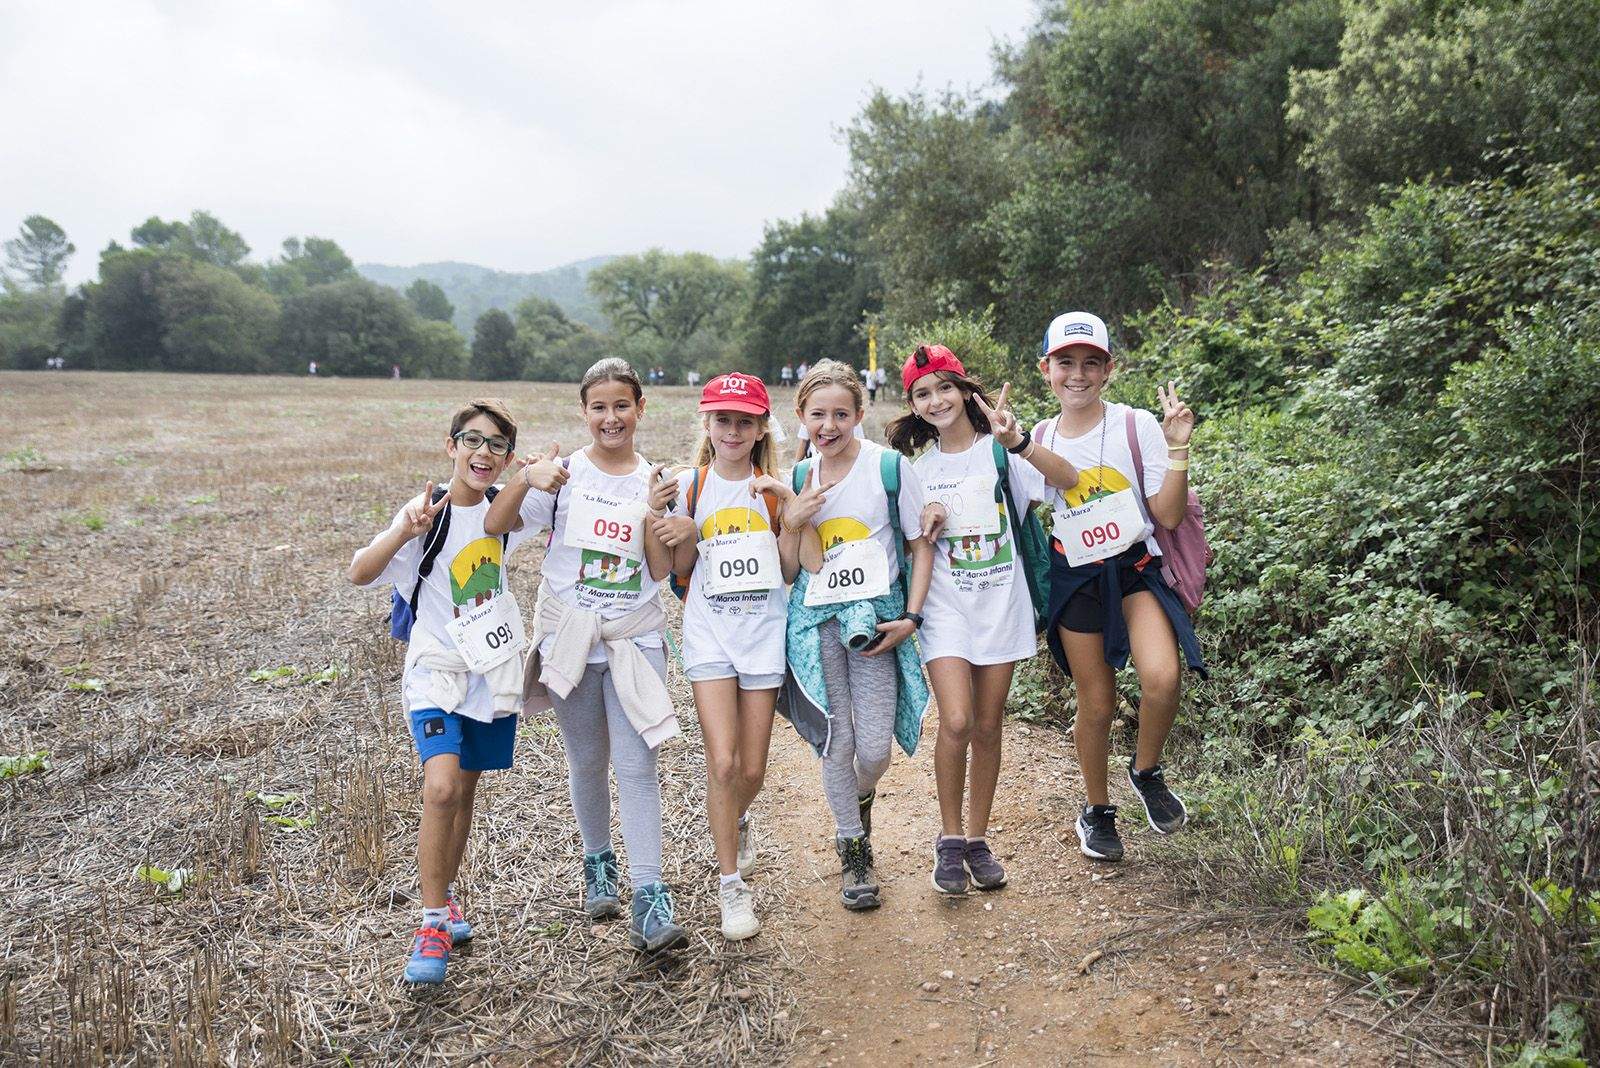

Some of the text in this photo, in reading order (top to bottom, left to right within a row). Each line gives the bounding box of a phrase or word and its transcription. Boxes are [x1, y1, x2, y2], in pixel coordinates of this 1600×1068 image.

[720, 377, 748, 389] TOT
[593, 519, 632, 543] 093
[1081, 521, 1120, 548] 090
[720, 557, 759, 578] 090
[828, 567, 865, 589] 080
[588, 589, 615, 598] Marxa
[742, 594, 768, 602] Infantil
[485, 622, 513, 650] 093
